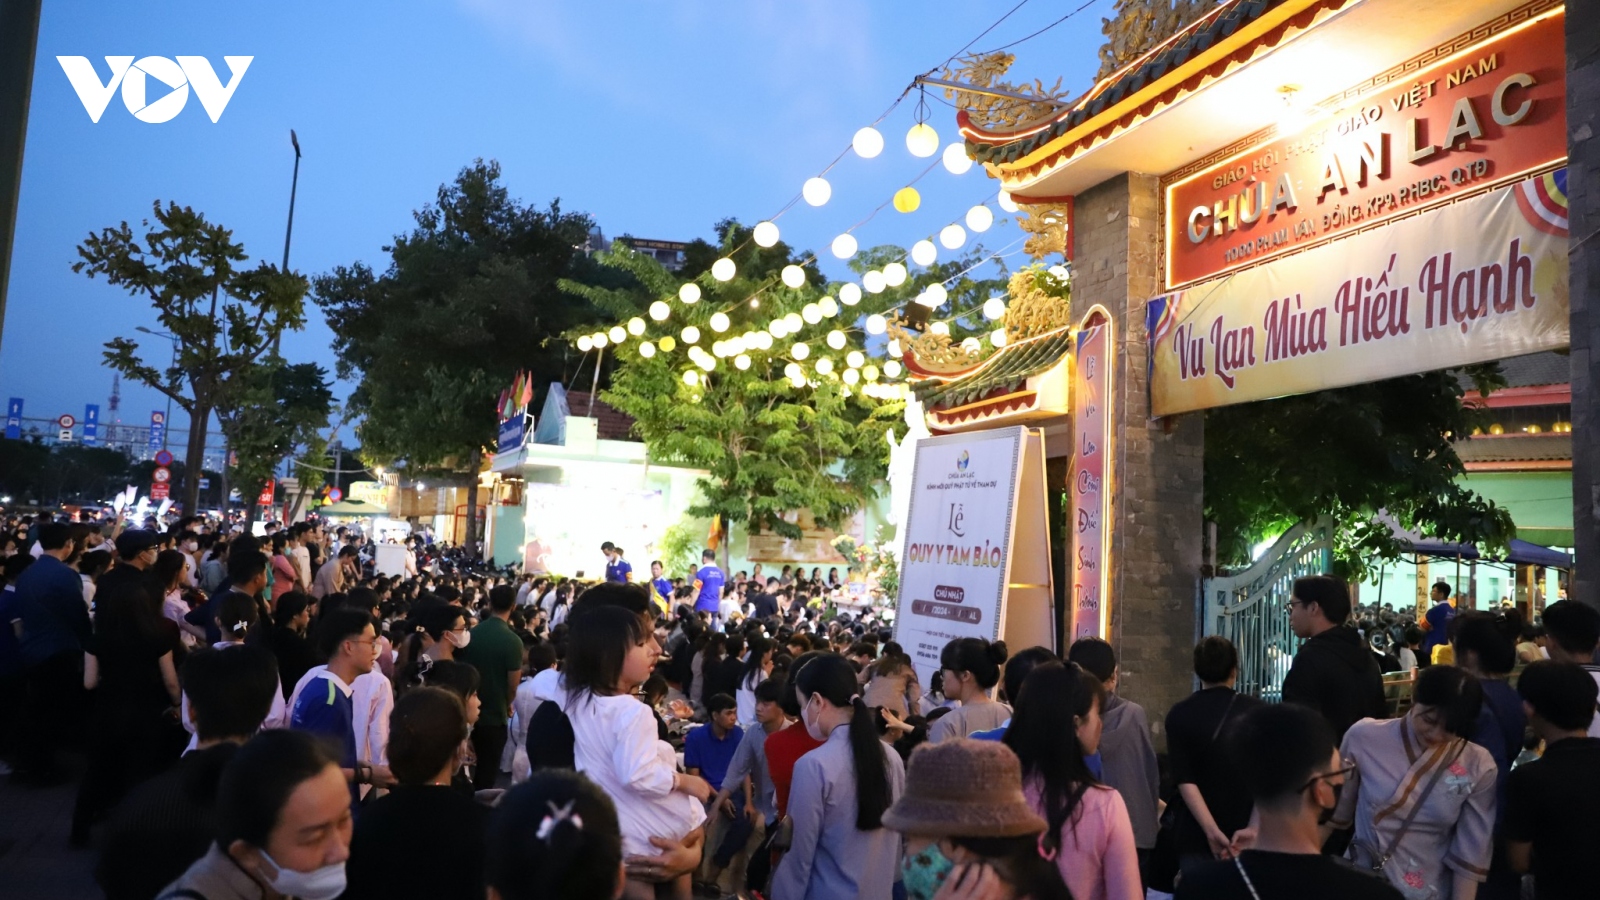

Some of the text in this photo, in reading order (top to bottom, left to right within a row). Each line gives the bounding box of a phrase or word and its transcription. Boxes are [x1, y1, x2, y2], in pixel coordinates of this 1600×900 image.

[1212, 165, 1247, 190] GIÁO
[1252, 149, 1279, 173] HỘI
[1337, 105, 1383, 136] GIÁO
[1390, 80, 1436, 111] VIỆT
[1446, 53, 1497, 89] NAM
[1187, 73, 1537, 244] CHÙA AN LẠC
[1450, 158, 1488, 185] Q.TĐ
[1174, 238, 1535, 389] Vu Lan Mùa Hiếu Hạnh
[948, 503, 965, 537] Lễ
[1078, 507, 1097, 533] Đức
[910, 539, 1001, 568] QUY Y TAM BẢO
[1077, 545, 1096, 571] Sinh
[936, 588, 963, 602] CHỦ NHẬT
